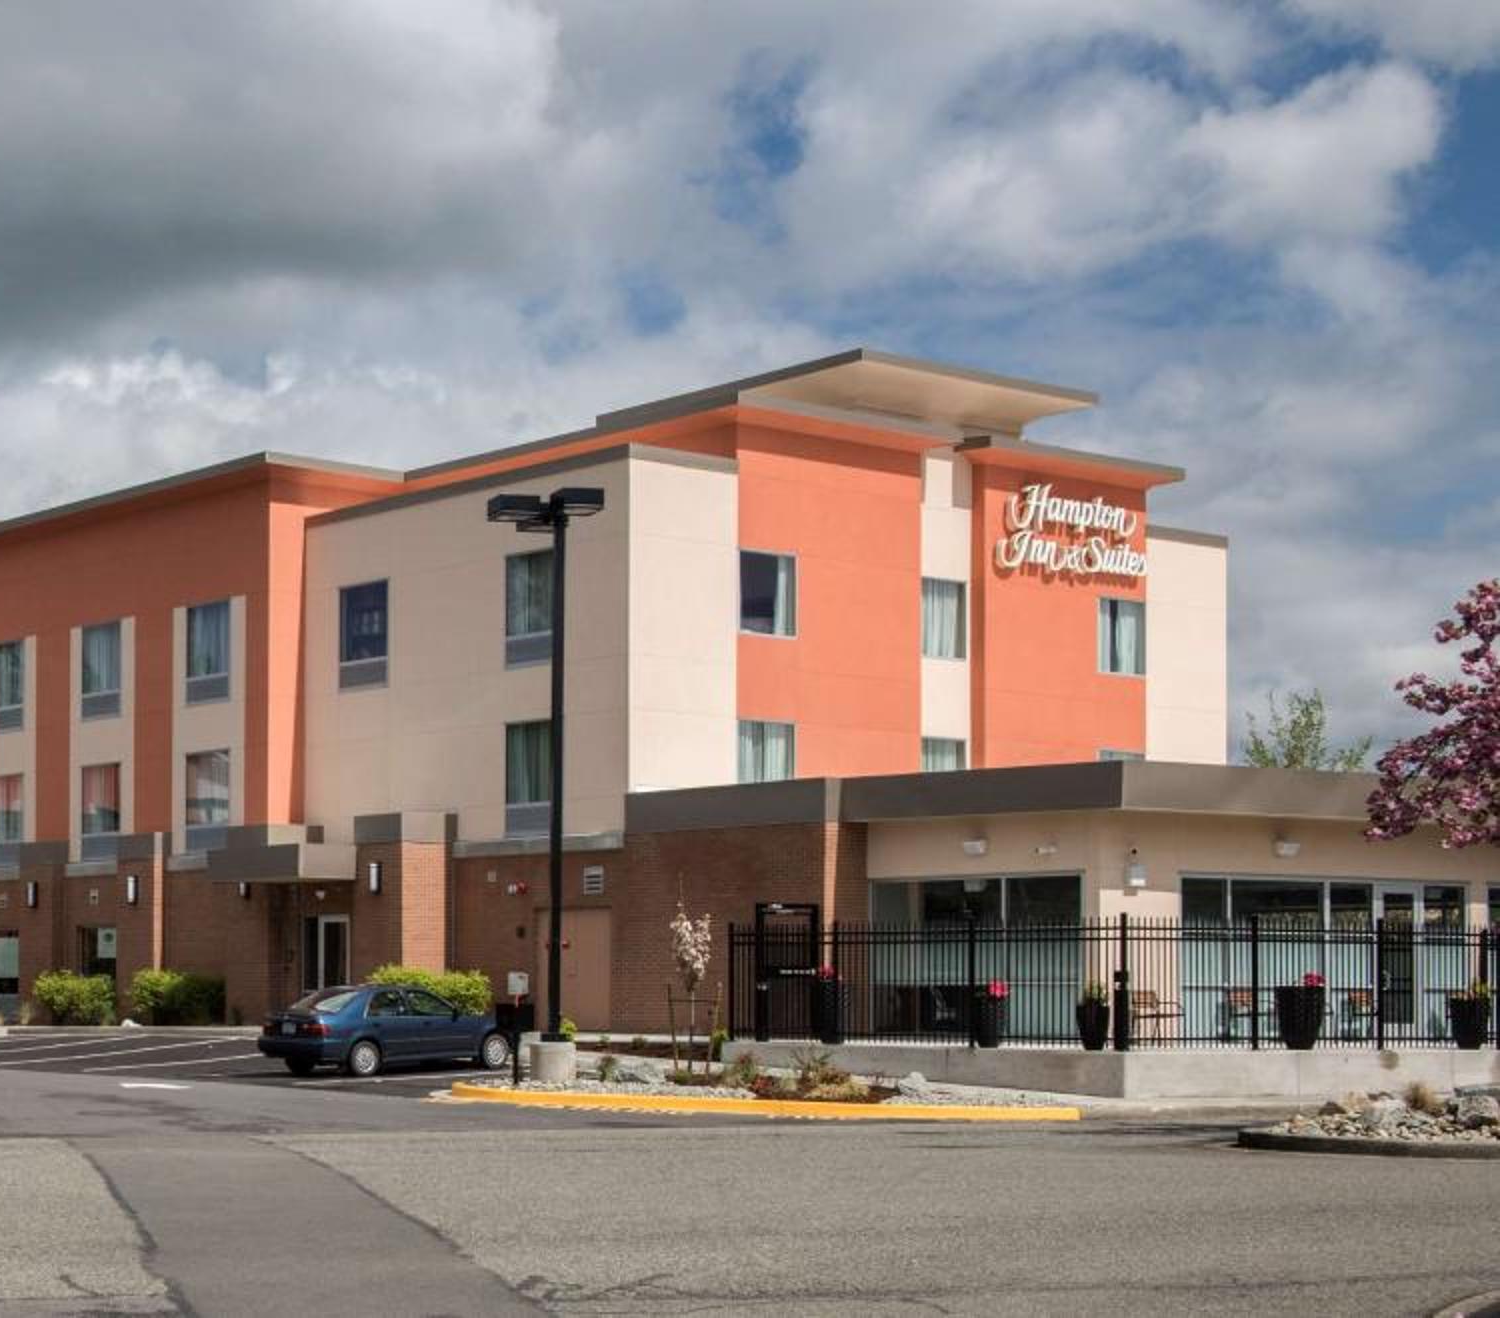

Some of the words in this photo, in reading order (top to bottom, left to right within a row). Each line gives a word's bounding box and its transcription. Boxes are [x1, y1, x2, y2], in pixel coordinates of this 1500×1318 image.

[1011, 484, 1136, 537] Hampton
[997, 530, 1066, 571] Inn
[1083, 536, 1147, 577] Suites
